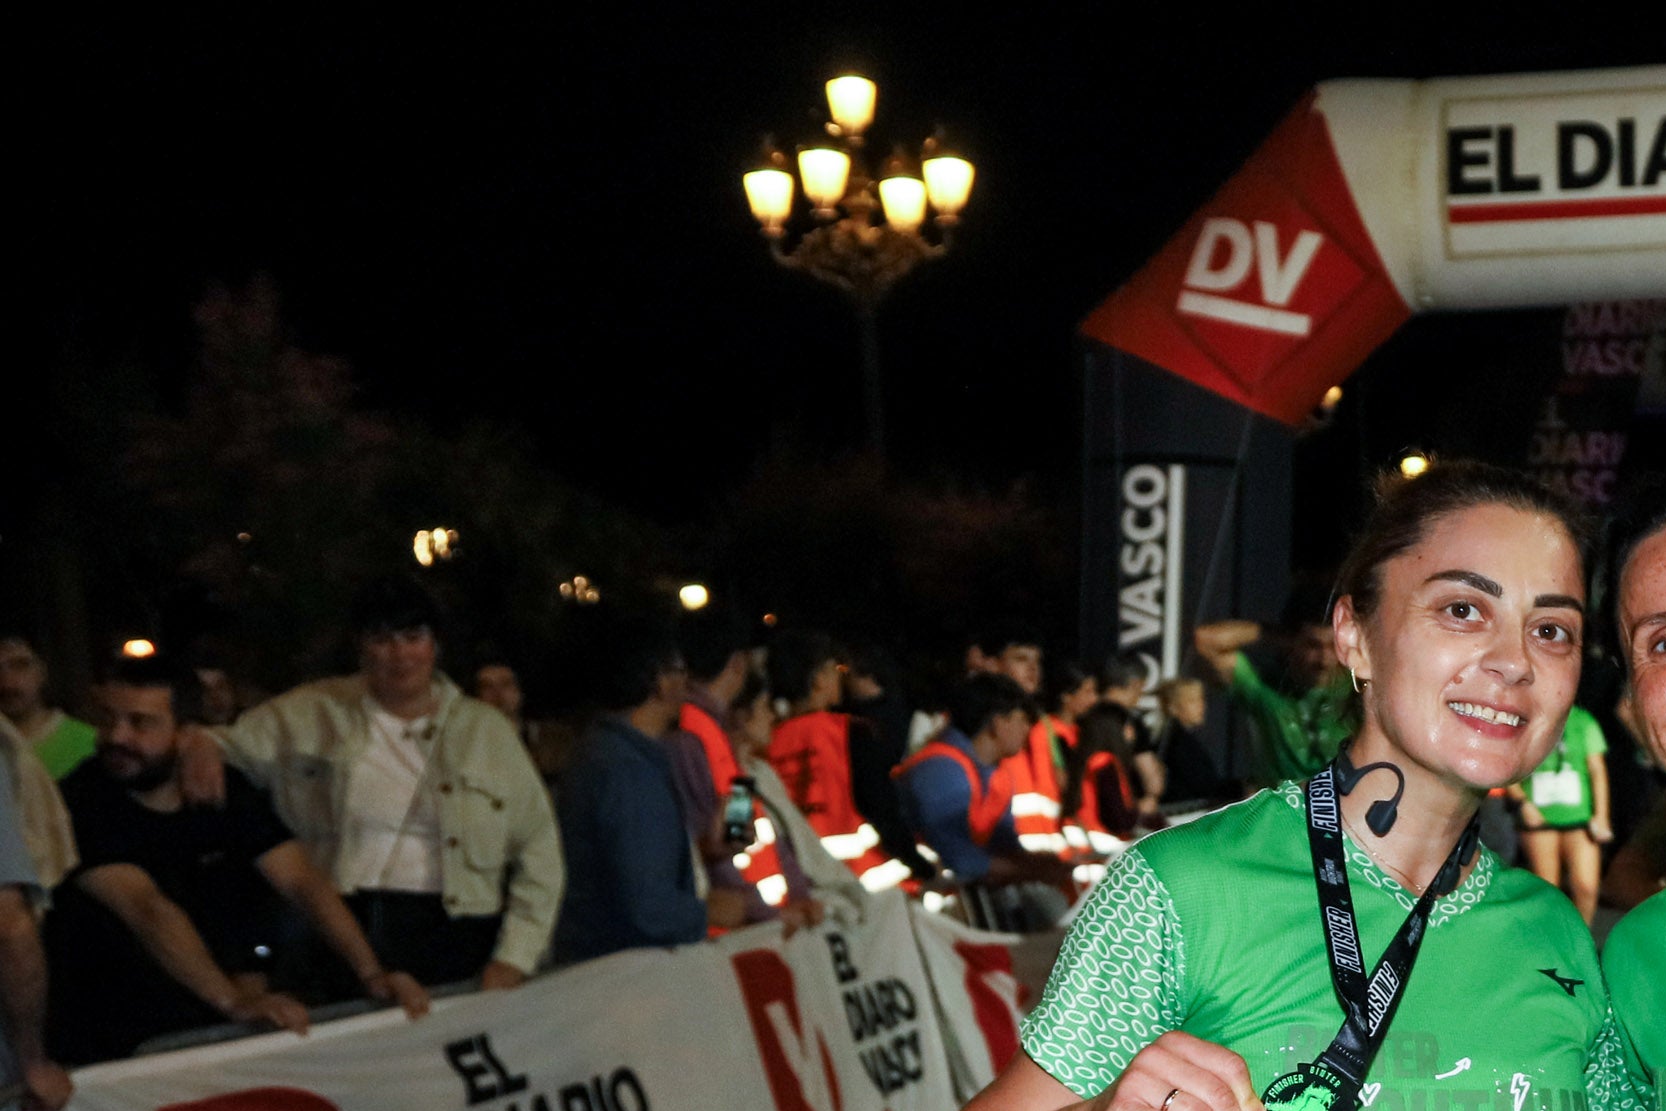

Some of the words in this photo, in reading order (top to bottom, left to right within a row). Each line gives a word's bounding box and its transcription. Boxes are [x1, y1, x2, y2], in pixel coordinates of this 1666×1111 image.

[1448, 125, 1540, 196] EL
[1183, 216, 1325, 306] DV
[1118, 463, 1168, 651] VASCO
[1325, 905, 1362, 974] FINISHER
[443, 1032, 529, 1105] EL
[1267, 1073, 1305, 1099] FINISHER
[1309, 1065, 1342, 1089] BINTER
